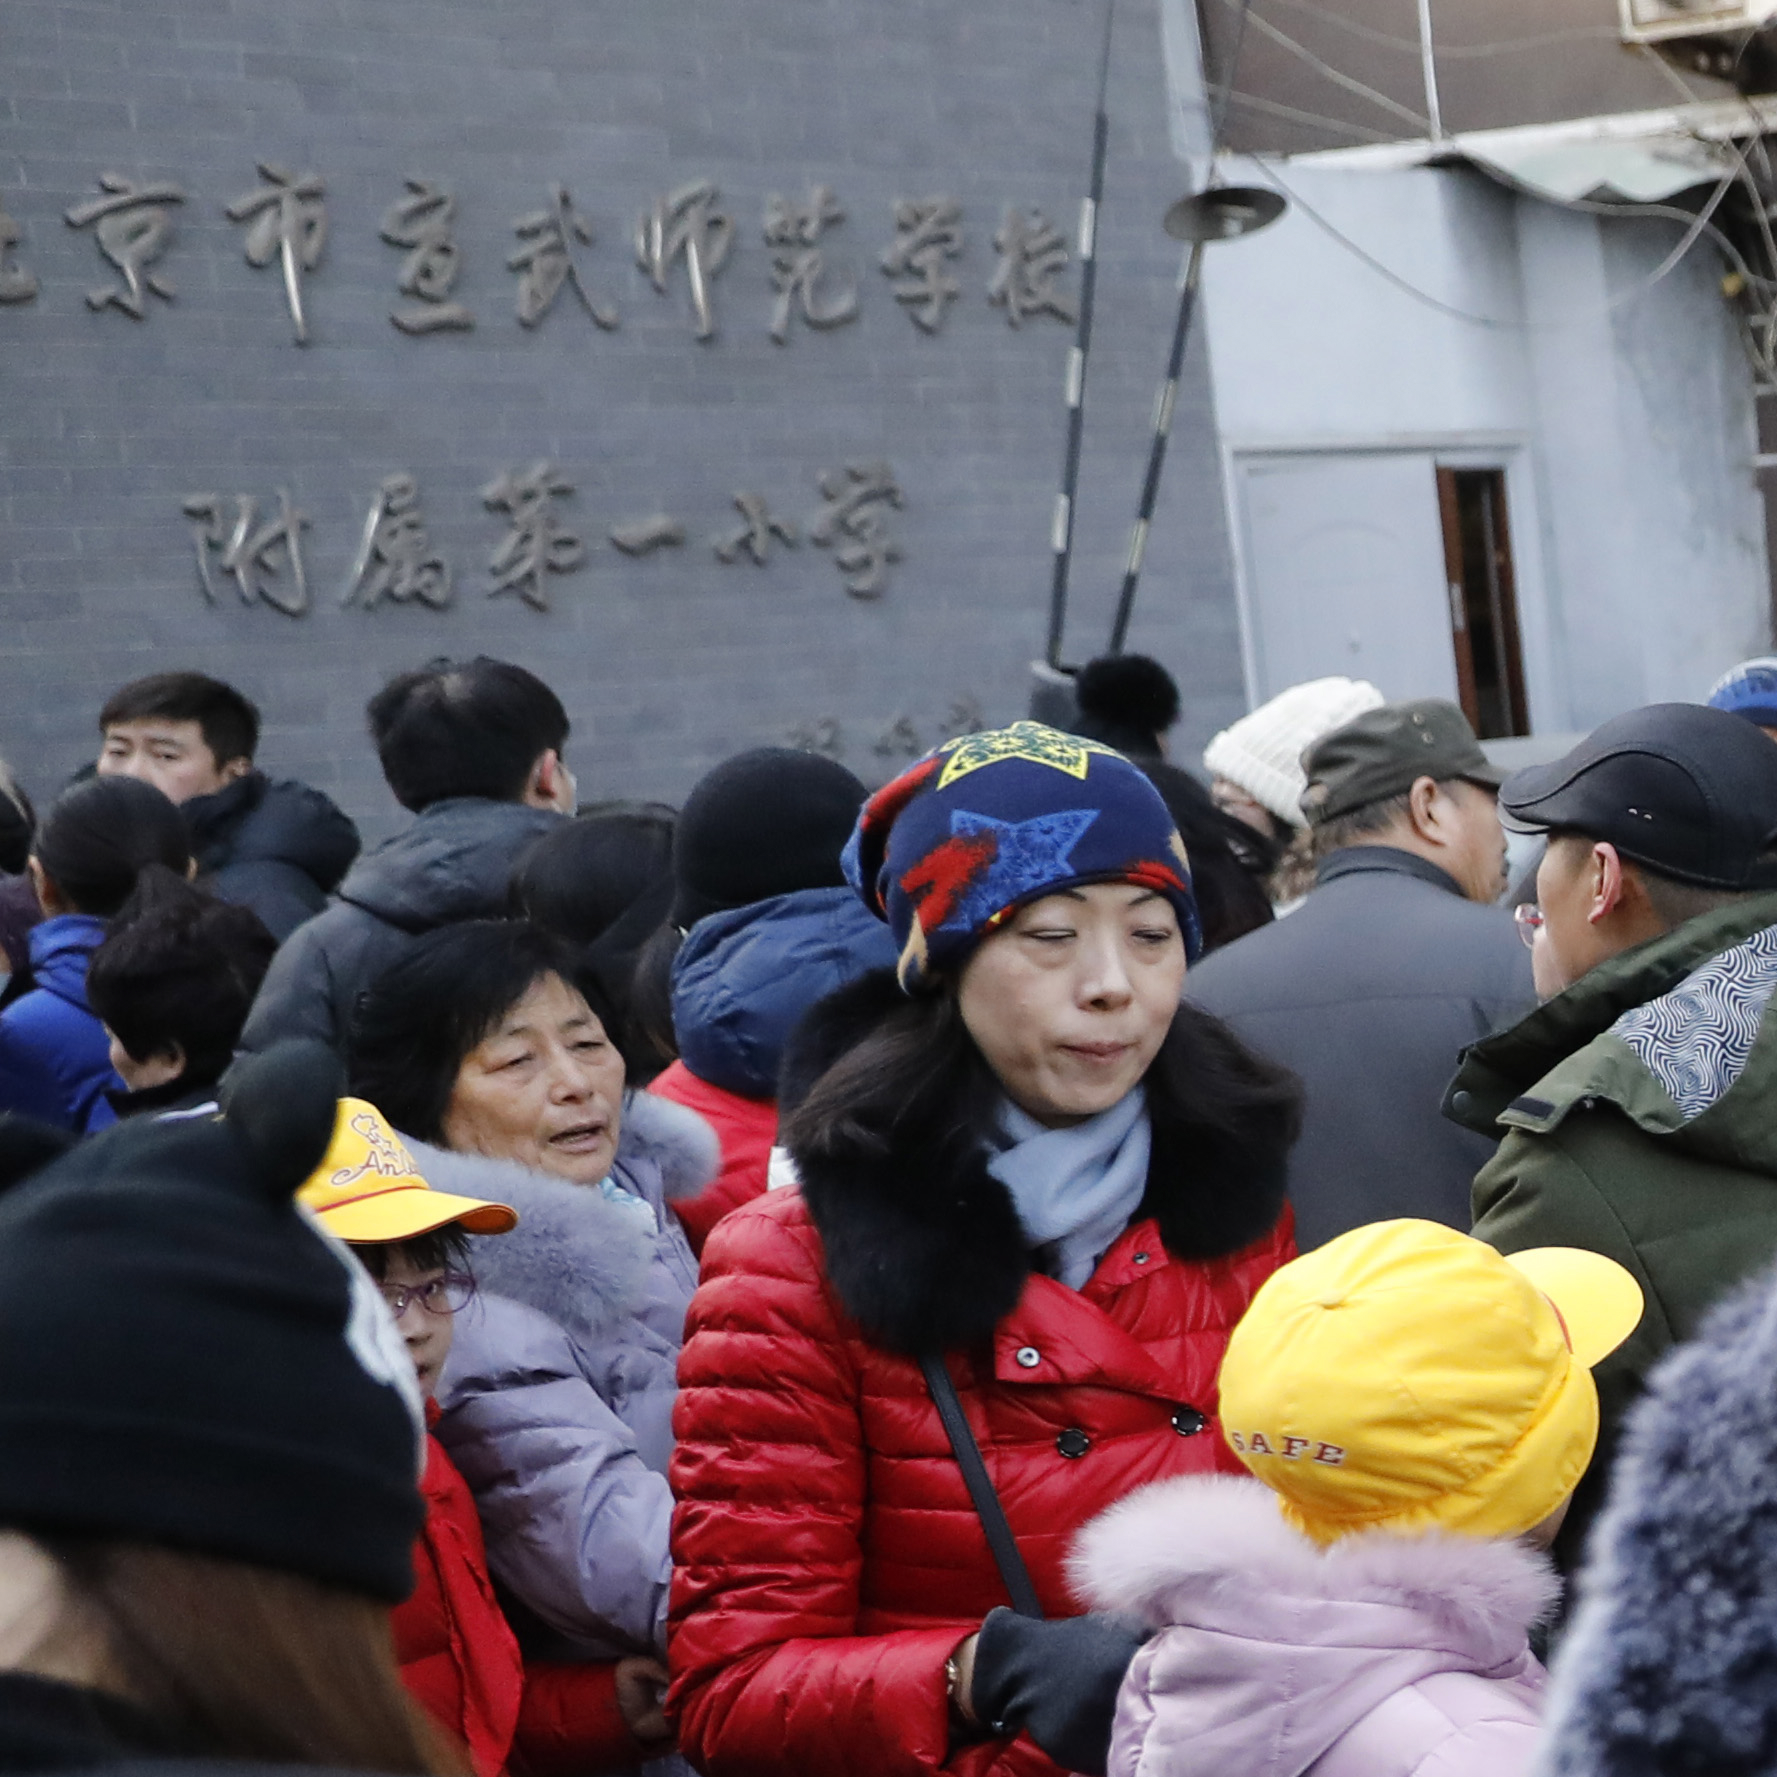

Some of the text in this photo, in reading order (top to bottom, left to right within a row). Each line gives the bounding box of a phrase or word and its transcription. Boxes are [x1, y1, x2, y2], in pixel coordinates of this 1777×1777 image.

[182, 462, 902, 617] 附属第一小学
[1232, 1432, 1345, 1464] SAFE
